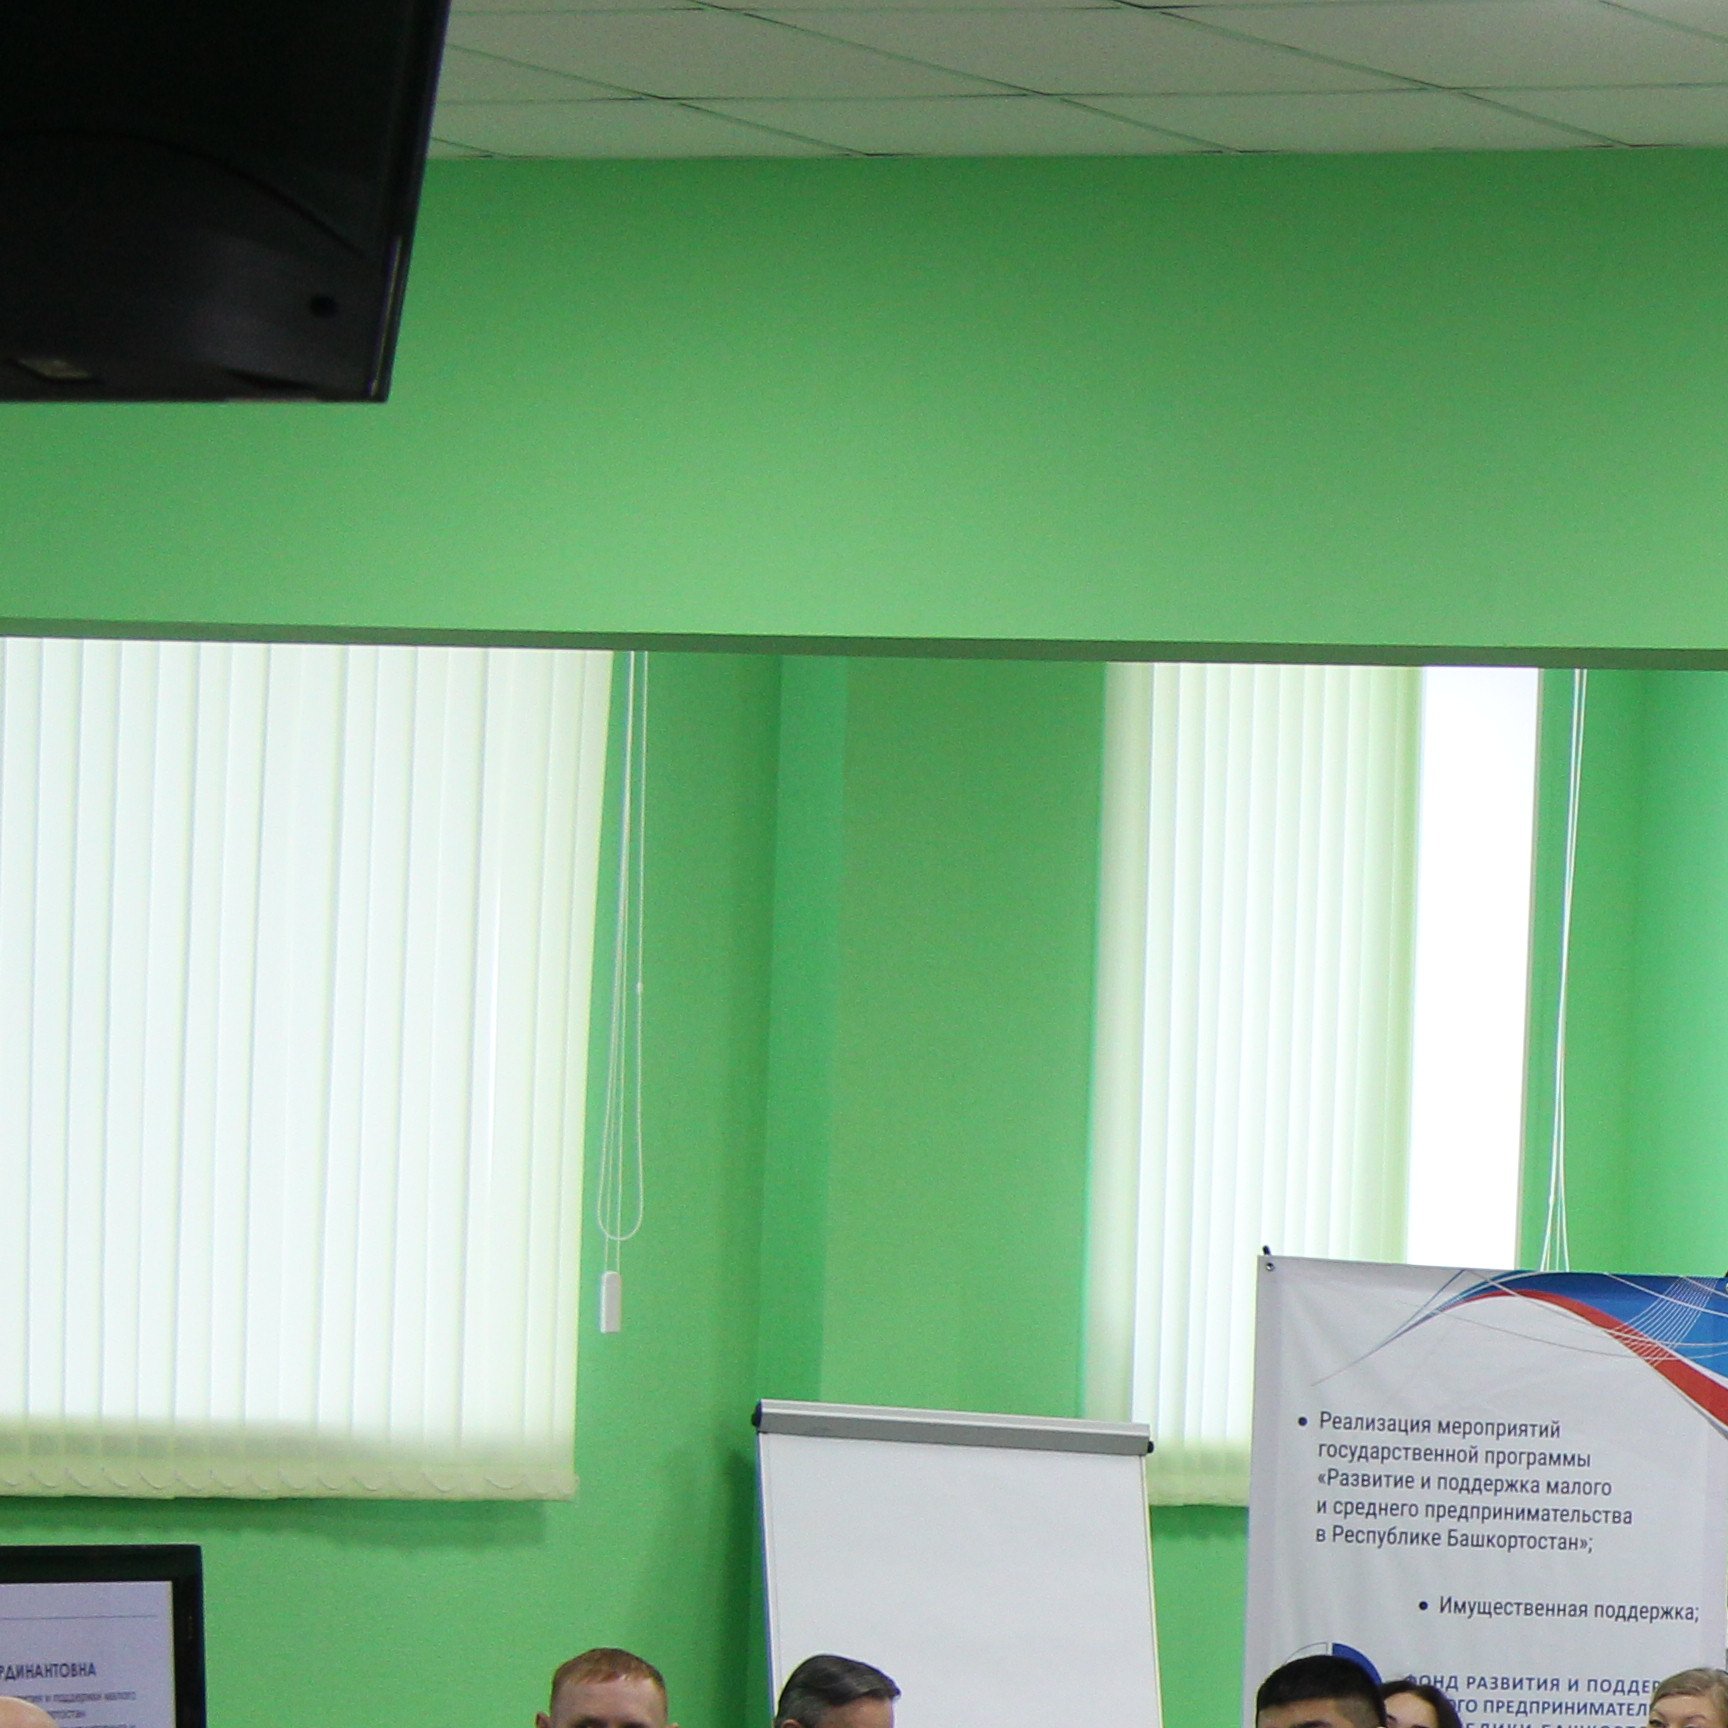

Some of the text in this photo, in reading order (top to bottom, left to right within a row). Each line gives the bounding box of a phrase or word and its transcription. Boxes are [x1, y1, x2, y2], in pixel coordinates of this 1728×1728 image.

[1320, 1411, 1561, 1442] Реализация мероприятий
[1318, 1443, 1590, 1469] государственной программы
[1317, 1469, 1612, 1498] «Развитие и поддержка малого
[1316, 1501, 1632, 1527] и среднего предпринимательства
[1315, 1525, 1593, 1554] в Республике Башкортостан»;
[1439, 1596, 1699, 1623] Имущественная поддержка;
[1466, 1676, 1560, 1691] РАЗВИТИЯ
[1568, 1680, 1579, 1692] И
[1587, 1679, 1660, 1696] ПОДДЕР
[1484, 1701, 1648, 1717] ПРЕДПРИНИМАТЕЛ
